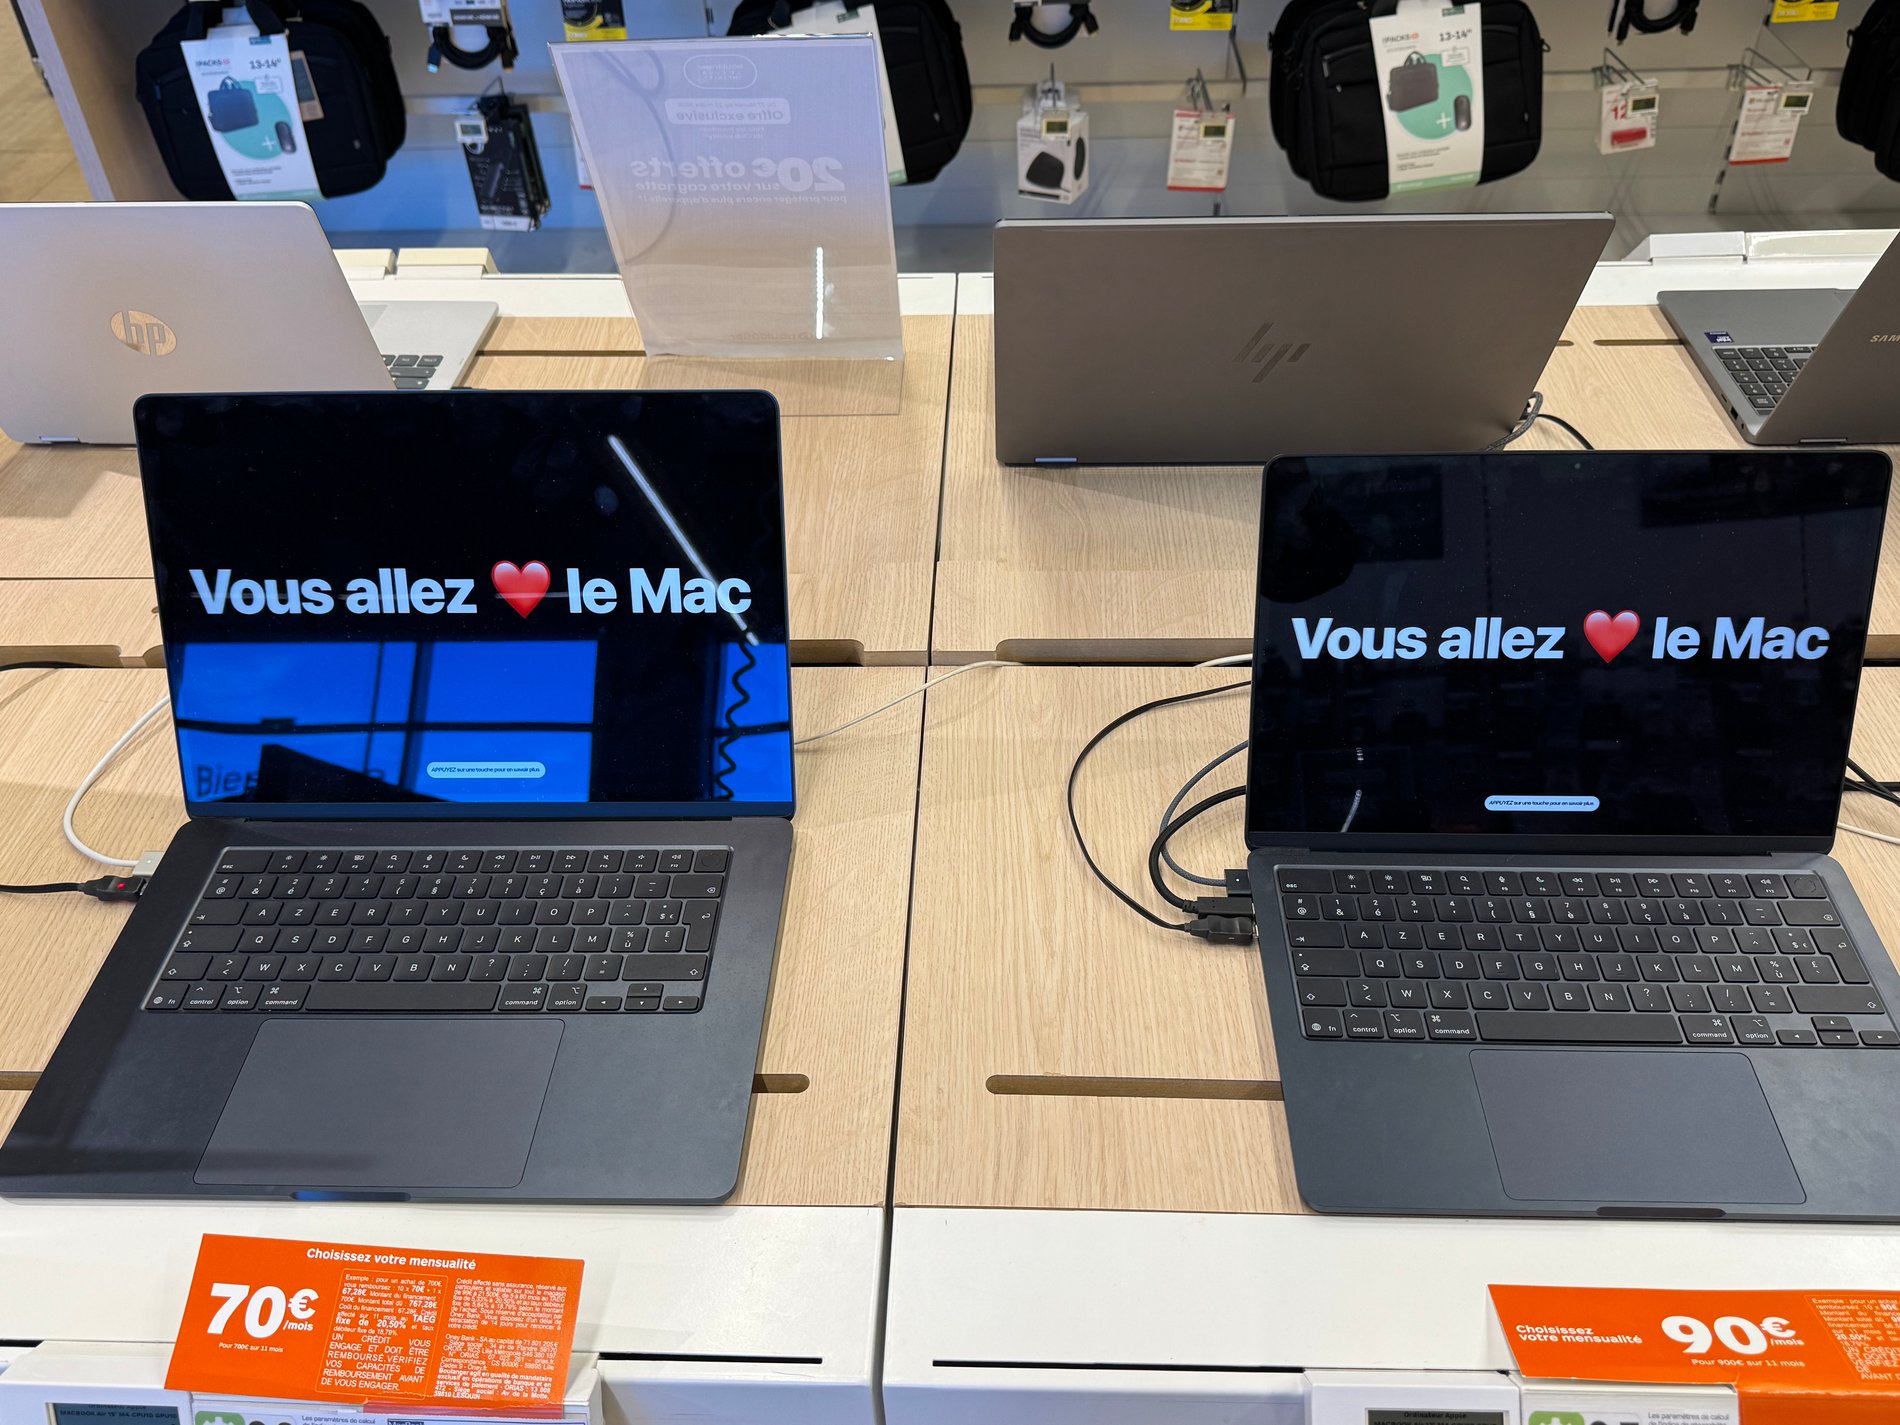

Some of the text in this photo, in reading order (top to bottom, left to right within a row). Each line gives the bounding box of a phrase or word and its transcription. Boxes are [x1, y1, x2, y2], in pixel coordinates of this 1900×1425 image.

[189, 568, 752, 614] Vous allez le Mac
[1292, 617, 1829, 659] Vous allez le Mac
[307, 1249, 476, 1269] Choisissez votre mensualité
[342, 1287, 367, 1296] 67,28€
[403, 1292, 436, 1300] financement
[361, 1305, 394, 1313] financement
[409, 1300, 438, 1308] 767,28€
[208, 1283, 318, 1338] 70€
[377, 1319, 406, 1329] 20,50%
[413, 1314, 436, 1323] TAEG
[283, 1320, 314, 1331] /mois
[1516, 1325, 1593, 1335] Choisissez
[361, 1335, 391, 1344] CRÉDIT
[409, 1339, 431, 1347] VOUS
[1519, 1332, 1642, 1344] votre mensualité
[1662, 1316, 1797, 1354] 90€
[1770, 1338, 1805, 1347] /mois
[330, 1342, 362, 1351] ENGAGE
[384, 1346, 403, 1354] DOIT
[409, 1347, 429, 1356] ÊTRE
[356, 1362, 400, 1372] CAPACITÉS
[415, 1366, 426, 1374] DE
[323, 1369, 424, 1383] REMBOURSEMENT AVANT
[334, 1379, 357, 1387] VOUS
[314, 1416, 349, 1424] paramètres
